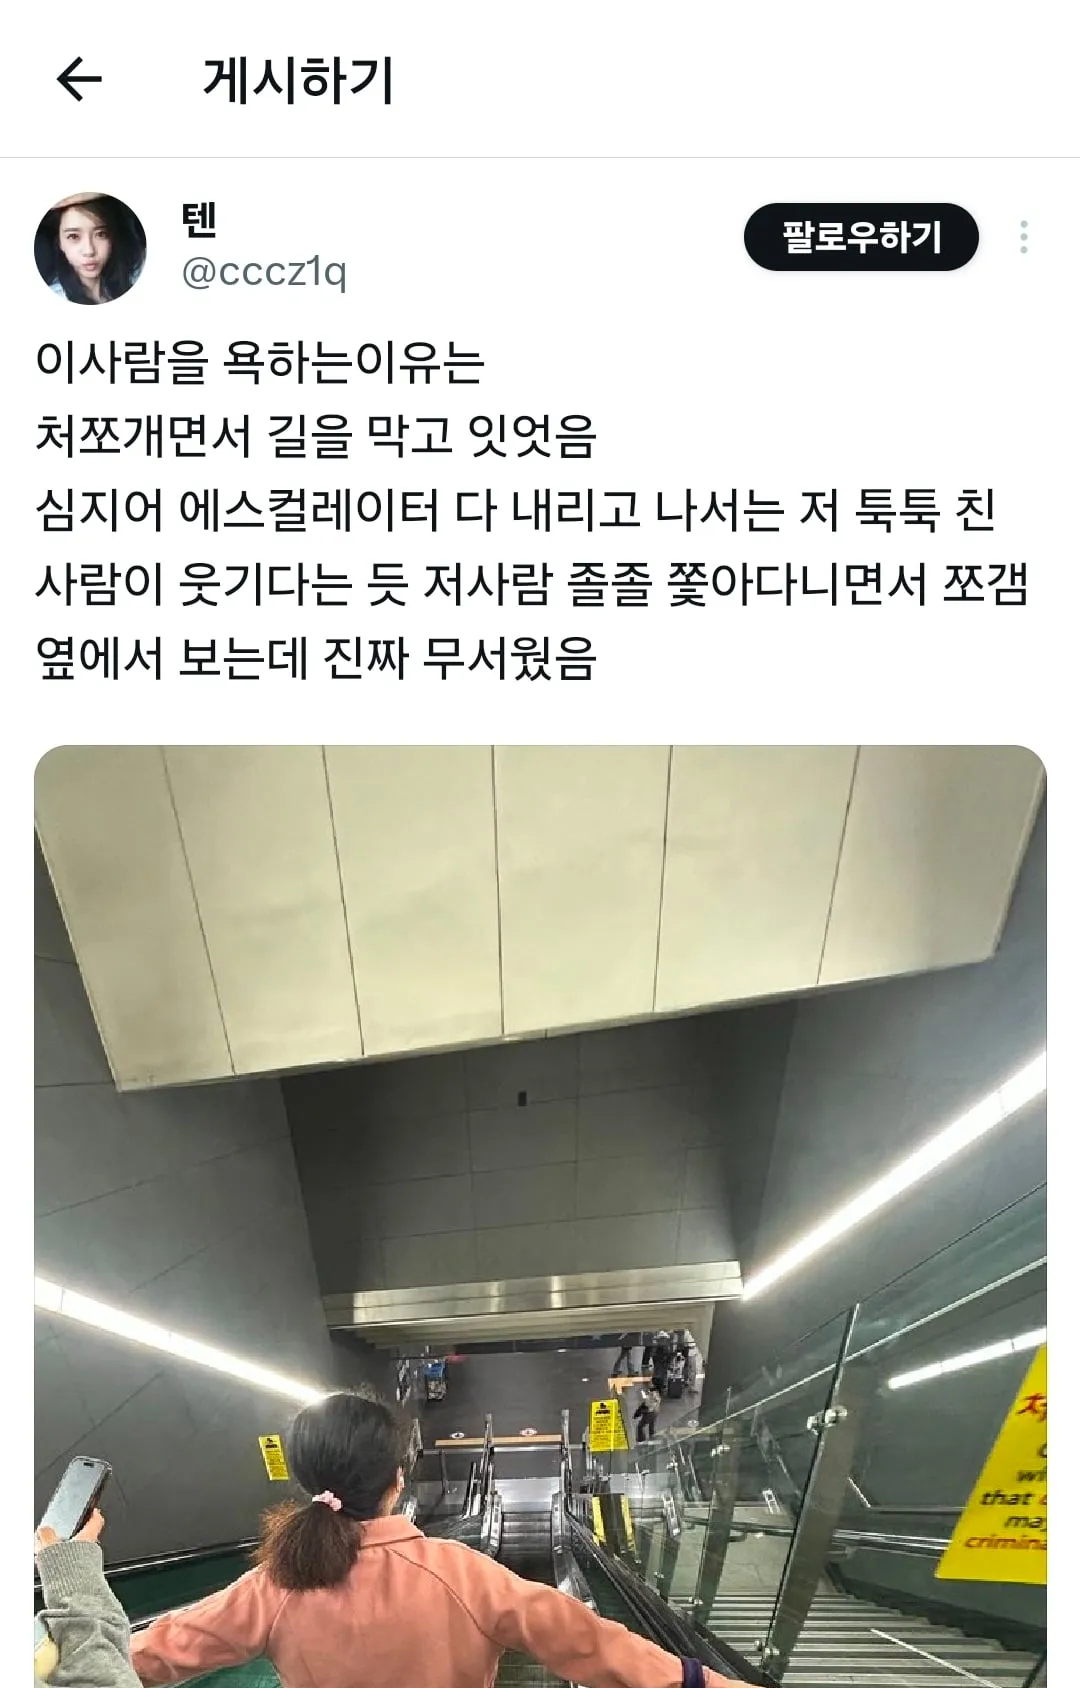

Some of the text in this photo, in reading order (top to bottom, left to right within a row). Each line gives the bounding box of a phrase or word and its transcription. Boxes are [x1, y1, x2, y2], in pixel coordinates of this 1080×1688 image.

[203, 55, 392, 105] 게시하기
[182, 201, 217, 239] 텐
[782, 220, 941, 254] 팔로우하기
[182, 254, 346, 294] @cccz1q
[36, 339, 485, 386] 이사람을 욕하는이유는
[35, 413, 597, 460] 처쪼개면서 길을 막고 잇엇음
[35, 487, 994, 534] 심지어 에스컬레이터 다 내리고 나서는 저 툭툭 친
[34, 562, 1027, 608] 사람이 웃기다는 듯 저사람 졸졸 쫓아다니면서 쪼갬
[37, 636, 597, 682] 옆에서 보는데 진짜 무서웠음
[981, 1490, 1034, 1505] that
